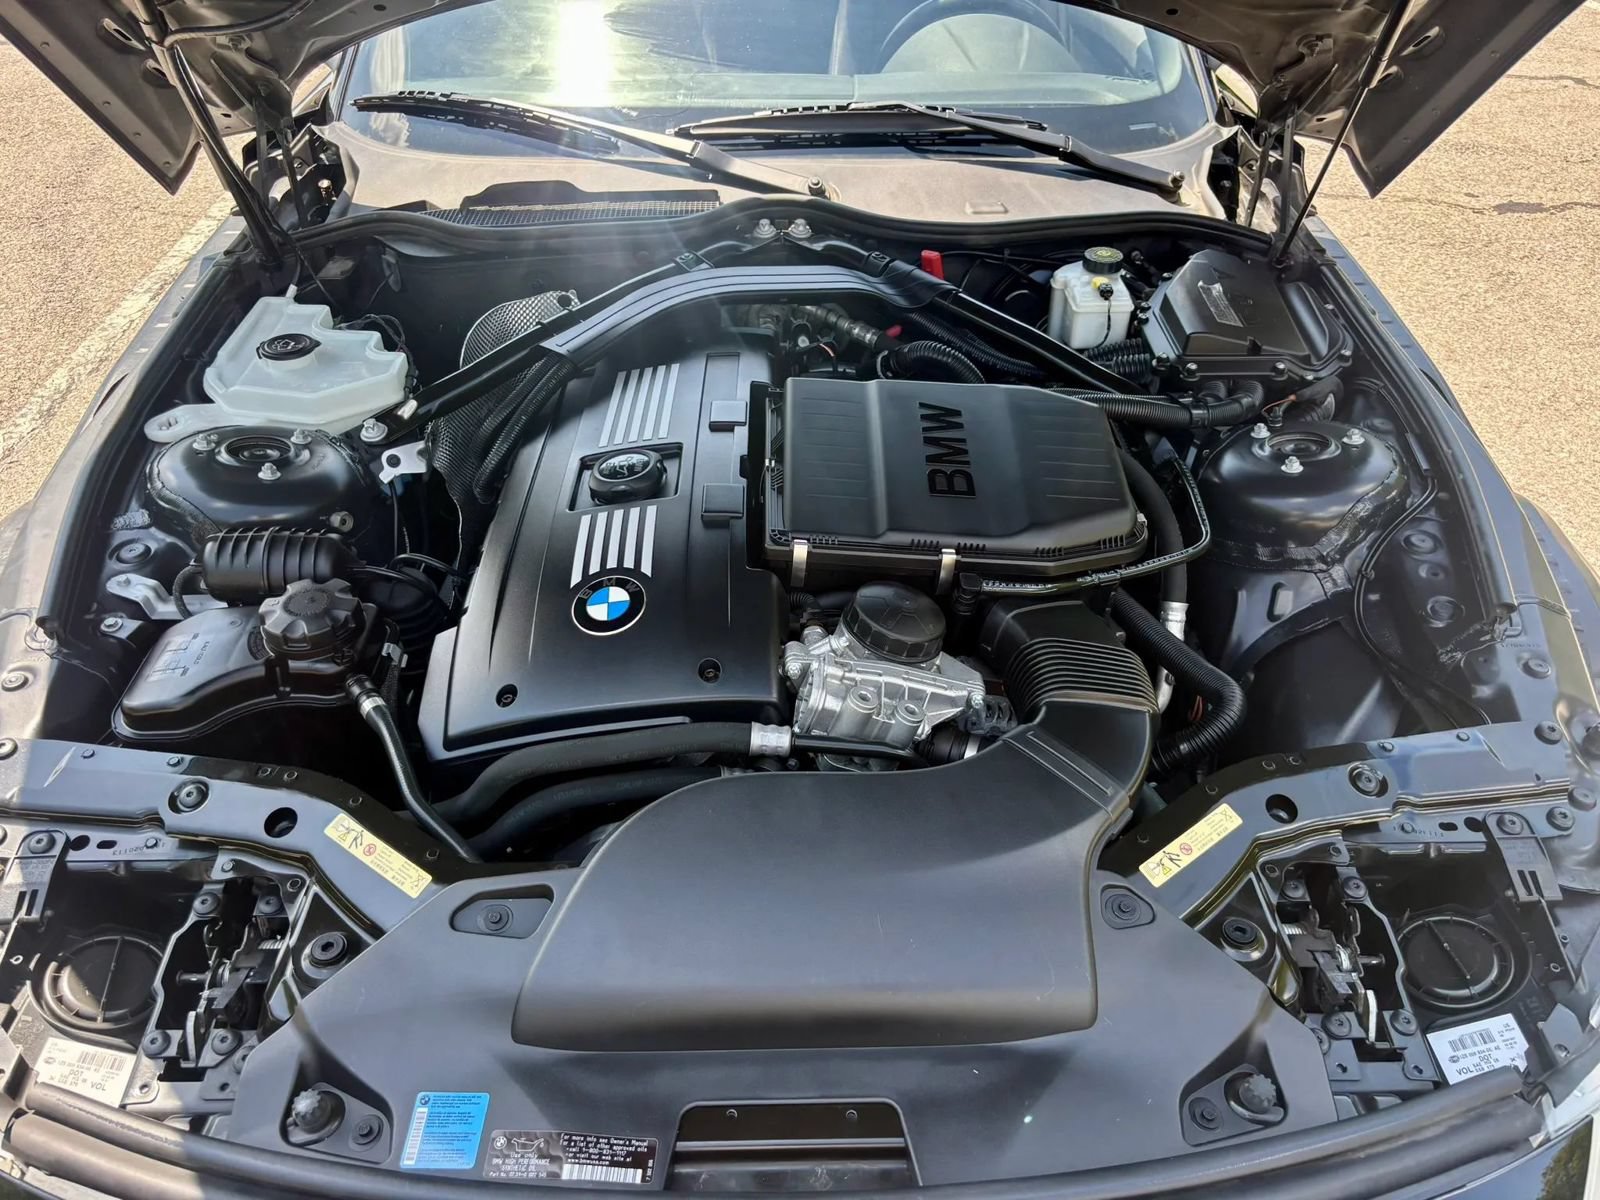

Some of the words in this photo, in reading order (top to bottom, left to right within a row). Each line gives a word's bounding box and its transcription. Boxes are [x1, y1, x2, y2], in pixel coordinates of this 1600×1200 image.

[919, 402, 976, 497] BMW
[579, 577, 640, 599] BMW
[1479, 1053, 1493, 1062] DOT
[1456, 1067, 1474, 1076] VOL
[90, 1081, 106, 1091] VOL
